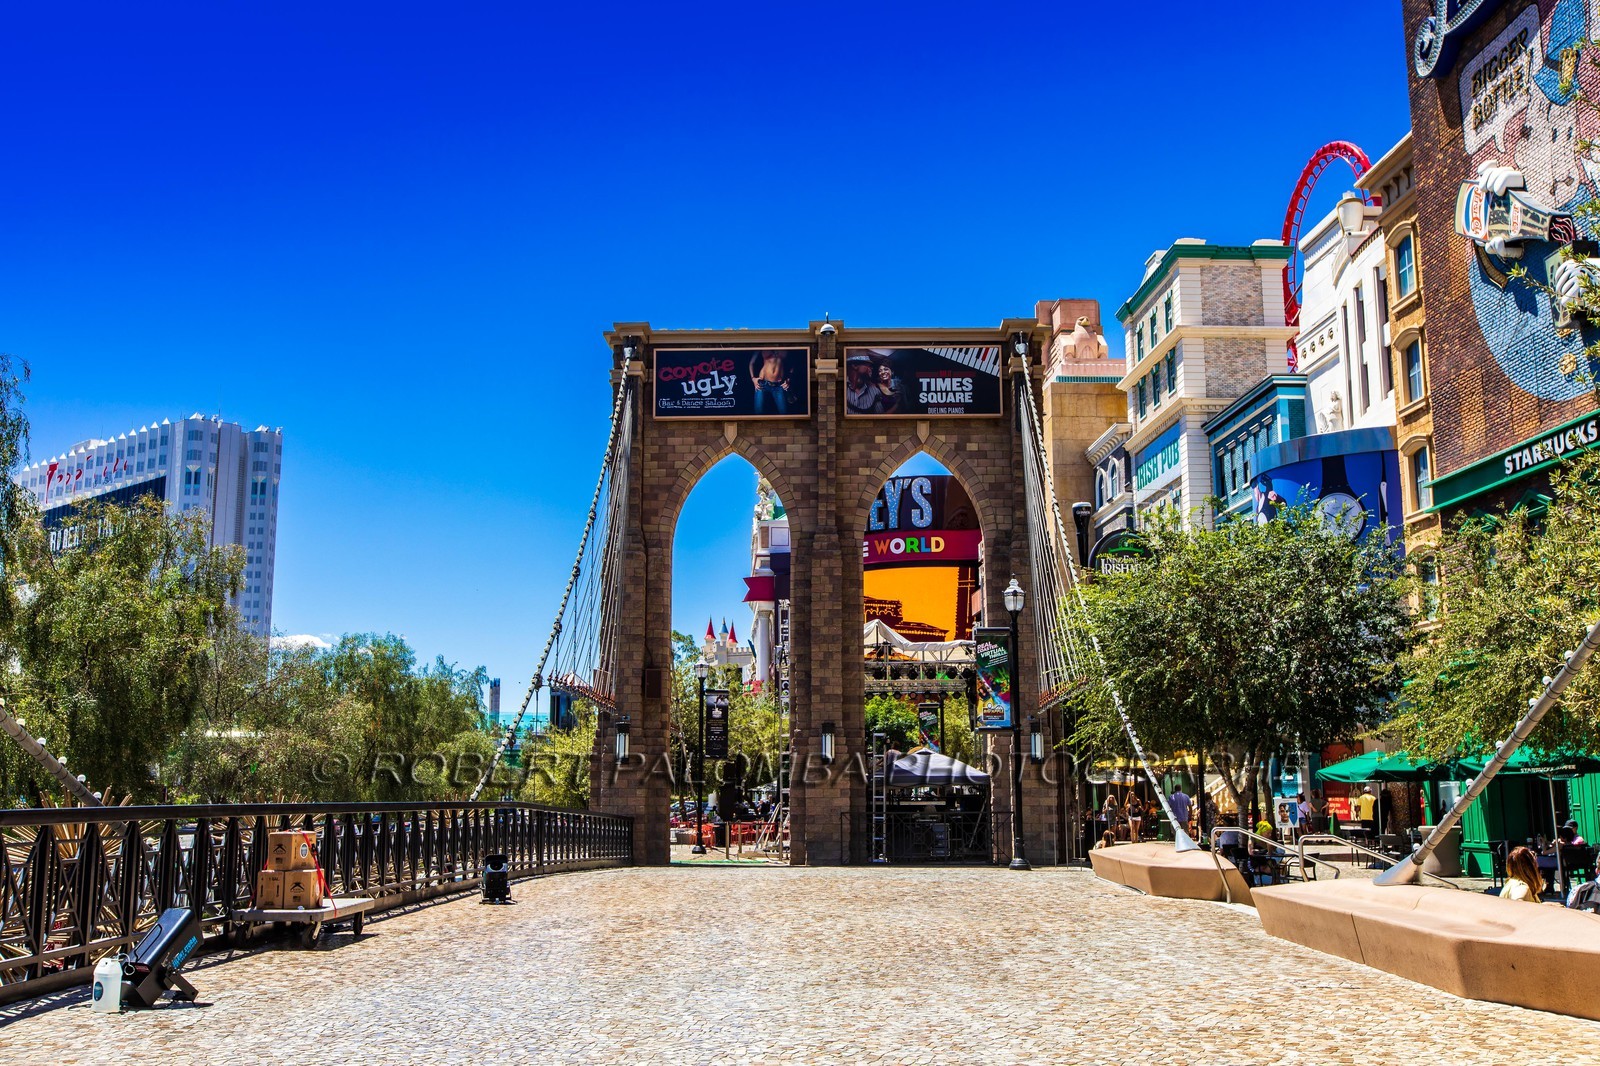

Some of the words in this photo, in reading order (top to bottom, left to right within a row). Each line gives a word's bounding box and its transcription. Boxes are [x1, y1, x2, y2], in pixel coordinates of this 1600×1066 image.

[1472, 27, 1528, 99] BIGGER
[659, 357, 735, 382] coyote
[681, 370, 737, 397] ugly
[919, 377, 973, 391] TIMES
[919, 391, 973, 404] SQUARE
[1504, 420, 1598, 475] STARBUCKS
[1136, 452, 1159, 491] IRISH
[1161, 438, 1180, 474] PUB
[874, 537, 945, 555] WORLD
[980, 646, 1006, 658] VIRTUAL
